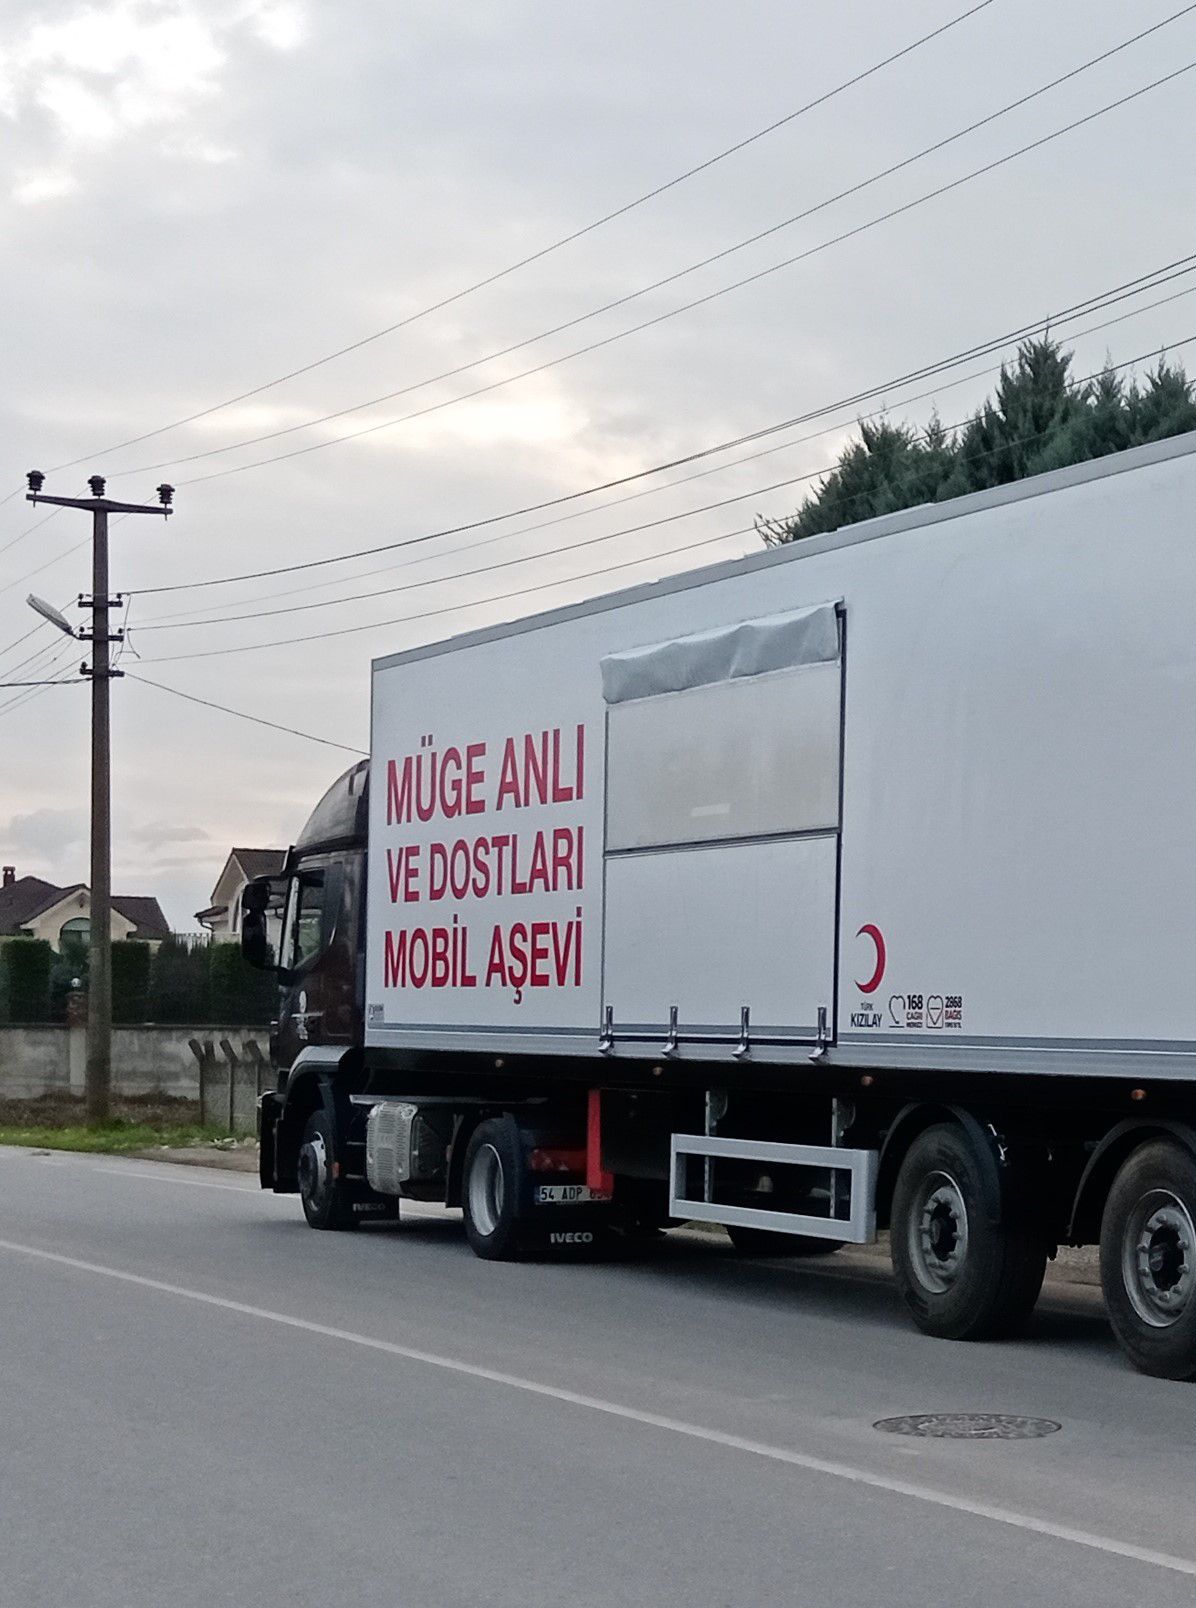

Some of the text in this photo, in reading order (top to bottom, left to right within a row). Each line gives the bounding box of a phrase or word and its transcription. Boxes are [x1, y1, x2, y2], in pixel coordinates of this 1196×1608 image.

[386, 724, 585, 827] MÜGE ANLI
[386, 826, 585, 904] VE DOSTLARI
[384, 906, 583, 1005] MOBİL AŞEVİ
[906, 994, 924, 1011] 168
[850, 1013, 882, 1028] KIZILAY
[541, 1187, 555, 1200] 54
[562, 1187, 583, 1200] ADP
[550, 1232, 594, 1244] IVECO
